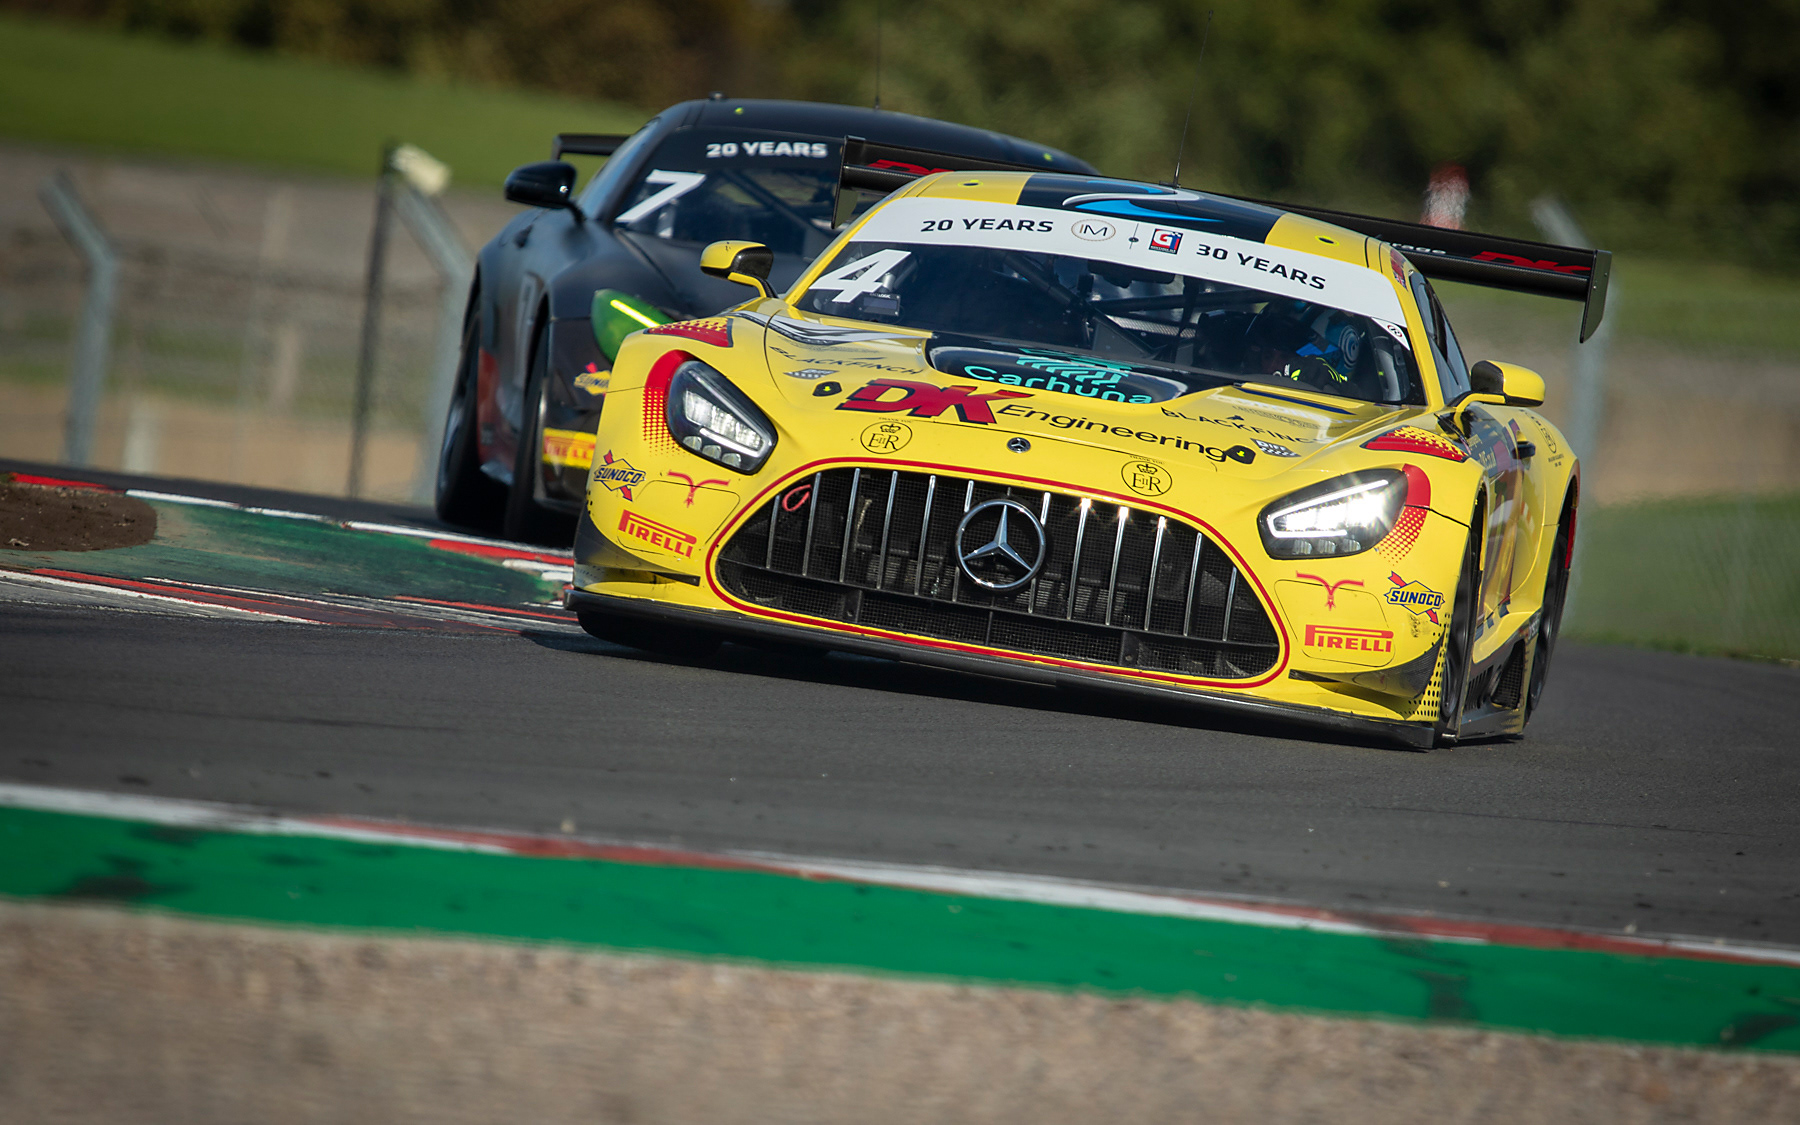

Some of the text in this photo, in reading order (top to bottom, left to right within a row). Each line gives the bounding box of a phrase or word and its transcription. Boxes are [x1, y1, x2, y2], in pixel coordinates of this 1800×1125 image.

[707, 142, 828, 158] 20 YEARS
[614, 169, 707, 224] 7
[920, 218, 1054, 233] 20 YEARS
[1079, 224, 1108, 237] IM
[809, 249, 912, 303] 4
[1196, 243, 1326, 290] 30 YEARS
[835, 378, 1036, 426] DK
[996, 404, 1228, 463] Engineering
[595, 467, 642, 484] SUNOCO
[617, 509, 697, 560] PIRELLI
[1390, 591, 1442, 607] SUNOCO
[1304, 624, 1395, 653] PIRELLI
